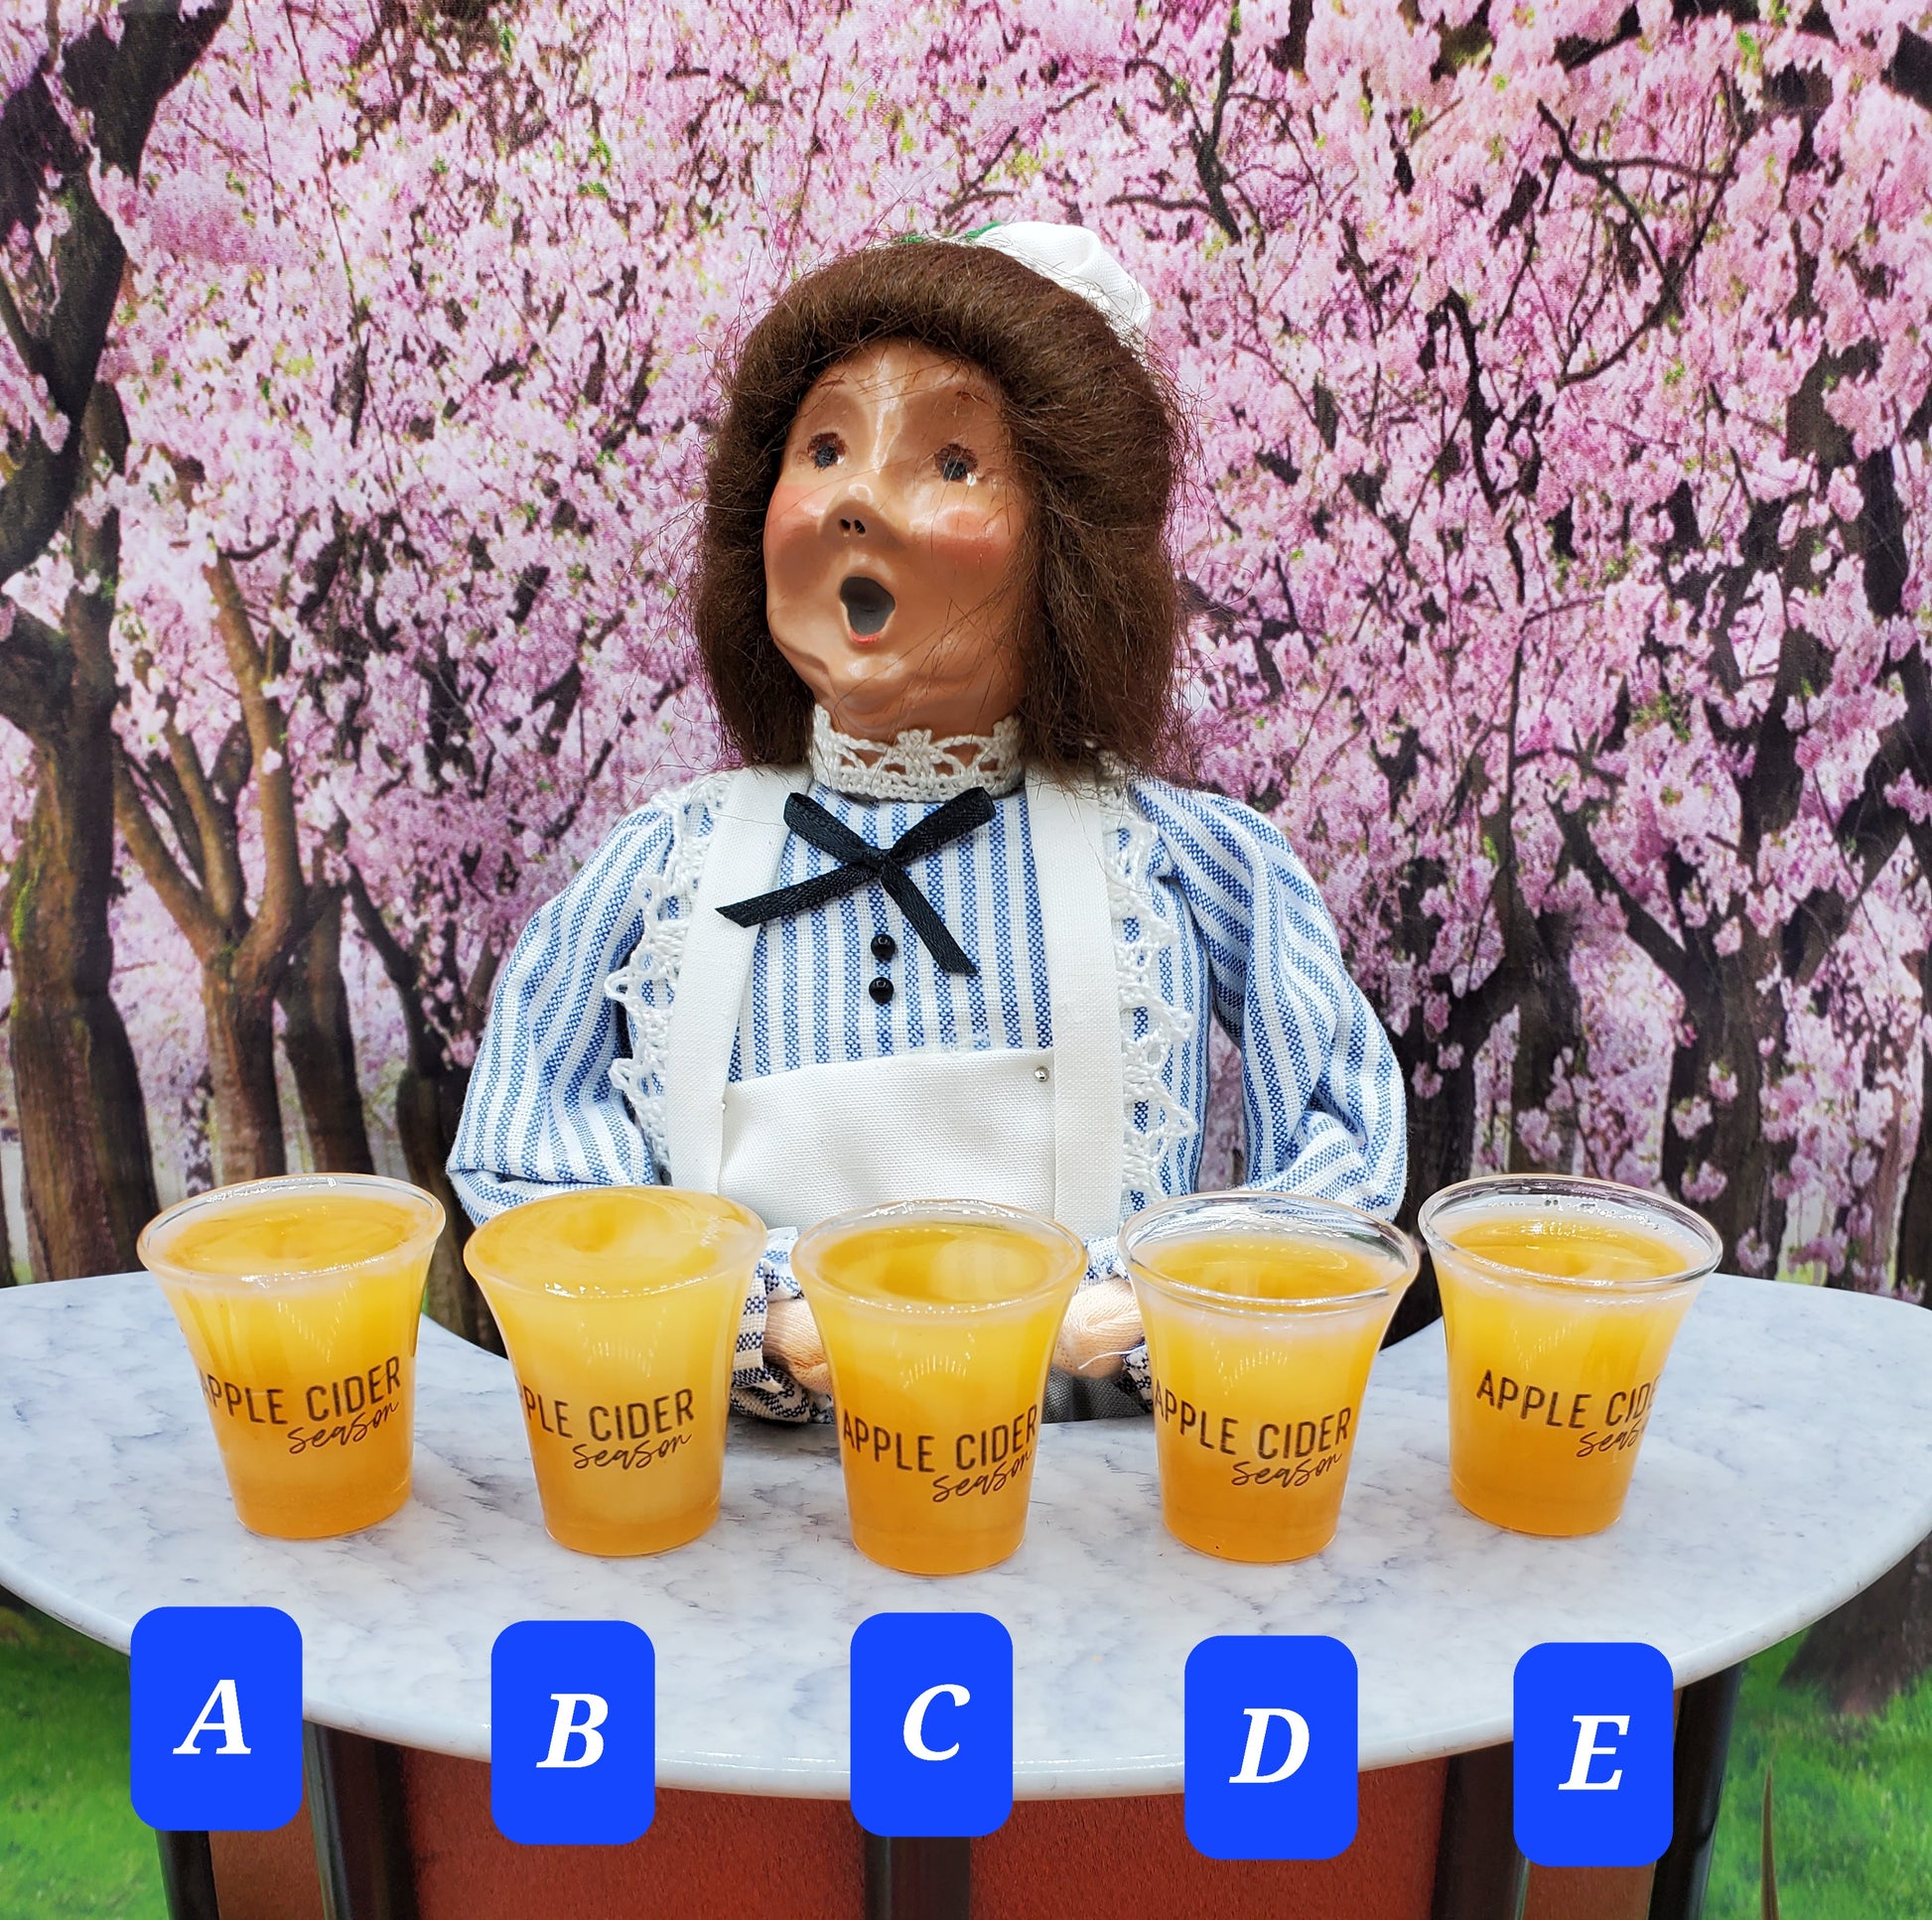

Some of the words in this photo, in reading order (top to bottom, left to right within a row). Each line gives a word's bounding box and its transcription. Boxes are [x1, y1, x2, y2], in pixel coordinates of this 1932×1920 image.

[305, 1355, 402, 1423] CIDER
[515, 1378, 574, 1440] PLE
[588, 1387, 695, 1442] CIDER
[1154, 1378, 1240, 1456] APPLE
[1257, 1406, 1352, 1460] CIDER
[1475, 1368, 1592, 1430] APPLE
[287, 1400, 400, 1455] season
[571, 1433, 693, 1471] season
[843, 1408, 936, 1473] APPLE
[955, 1403, 1038, 1471] CIDER
[931, 1448, 1034, 1503] season
[1231, 1451, 1343, 1489] season
